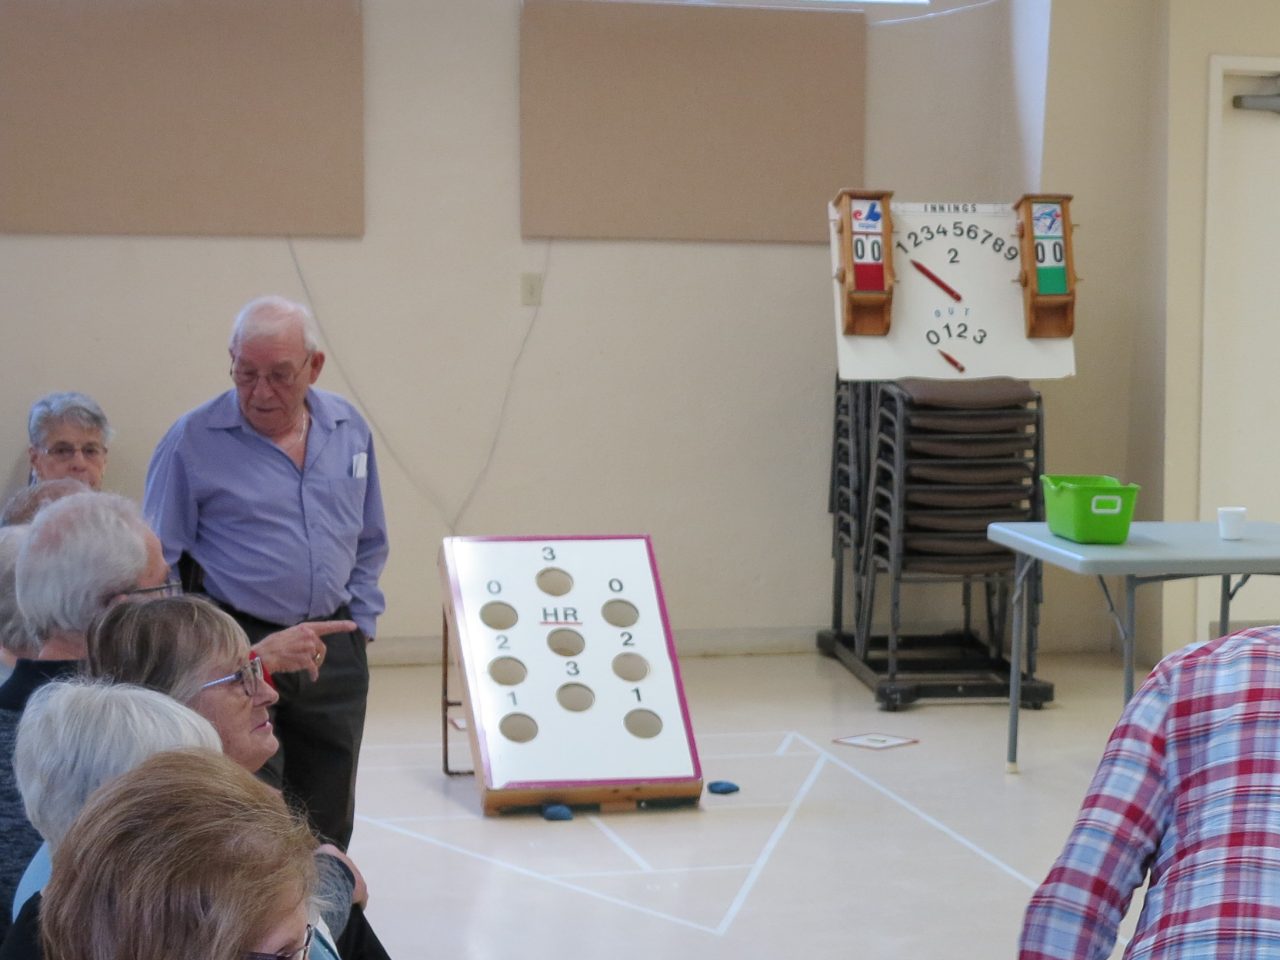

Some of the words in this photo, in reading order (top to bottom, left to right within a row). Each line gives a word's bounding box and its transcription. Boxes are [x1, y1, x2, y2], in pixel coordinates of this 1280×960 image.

[923, 203, 977, 214] INNINGS
[947, 247, 960, 263] 2
[542, 546, 556, 561] 3
[486, 580, 502, 595] 0
[608, 578, 624, 593] 0
[542, 607, 579, 622] HR
[496, 635, 510, 650] 2
[620, 632, 635, 647] 2
[565, 661, 581, 676] 3
[507, 691, 518, 707] 1
[631, 687, 643, 702] 1
